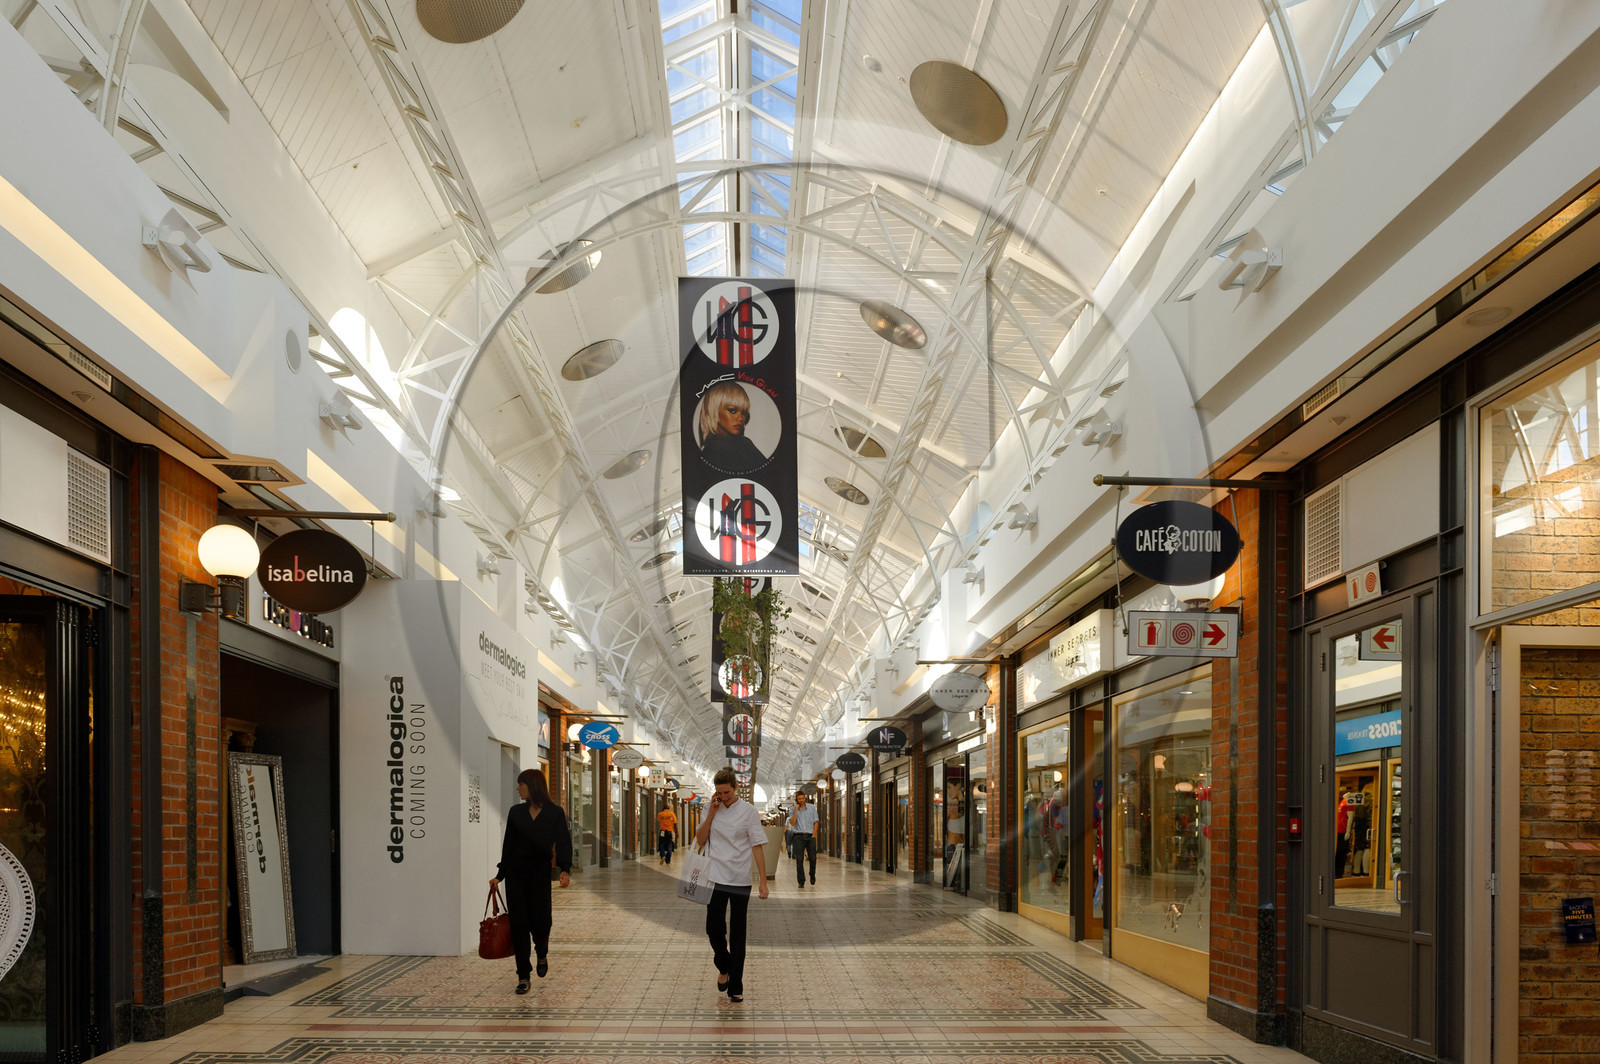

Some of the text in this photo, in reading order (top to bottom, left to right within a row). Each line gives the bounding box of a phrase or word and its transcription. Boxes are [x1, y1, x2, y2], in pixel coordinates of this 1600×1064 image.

[1135, 526, 1222, 552] CAFÉ COTON
[267, 555, 354, 583] isabelina
[479, 631, 526, 680] dermalogica
[387, 676, 407, 864] dermalogica
[410, 703, 426, 839] COMING SOON
